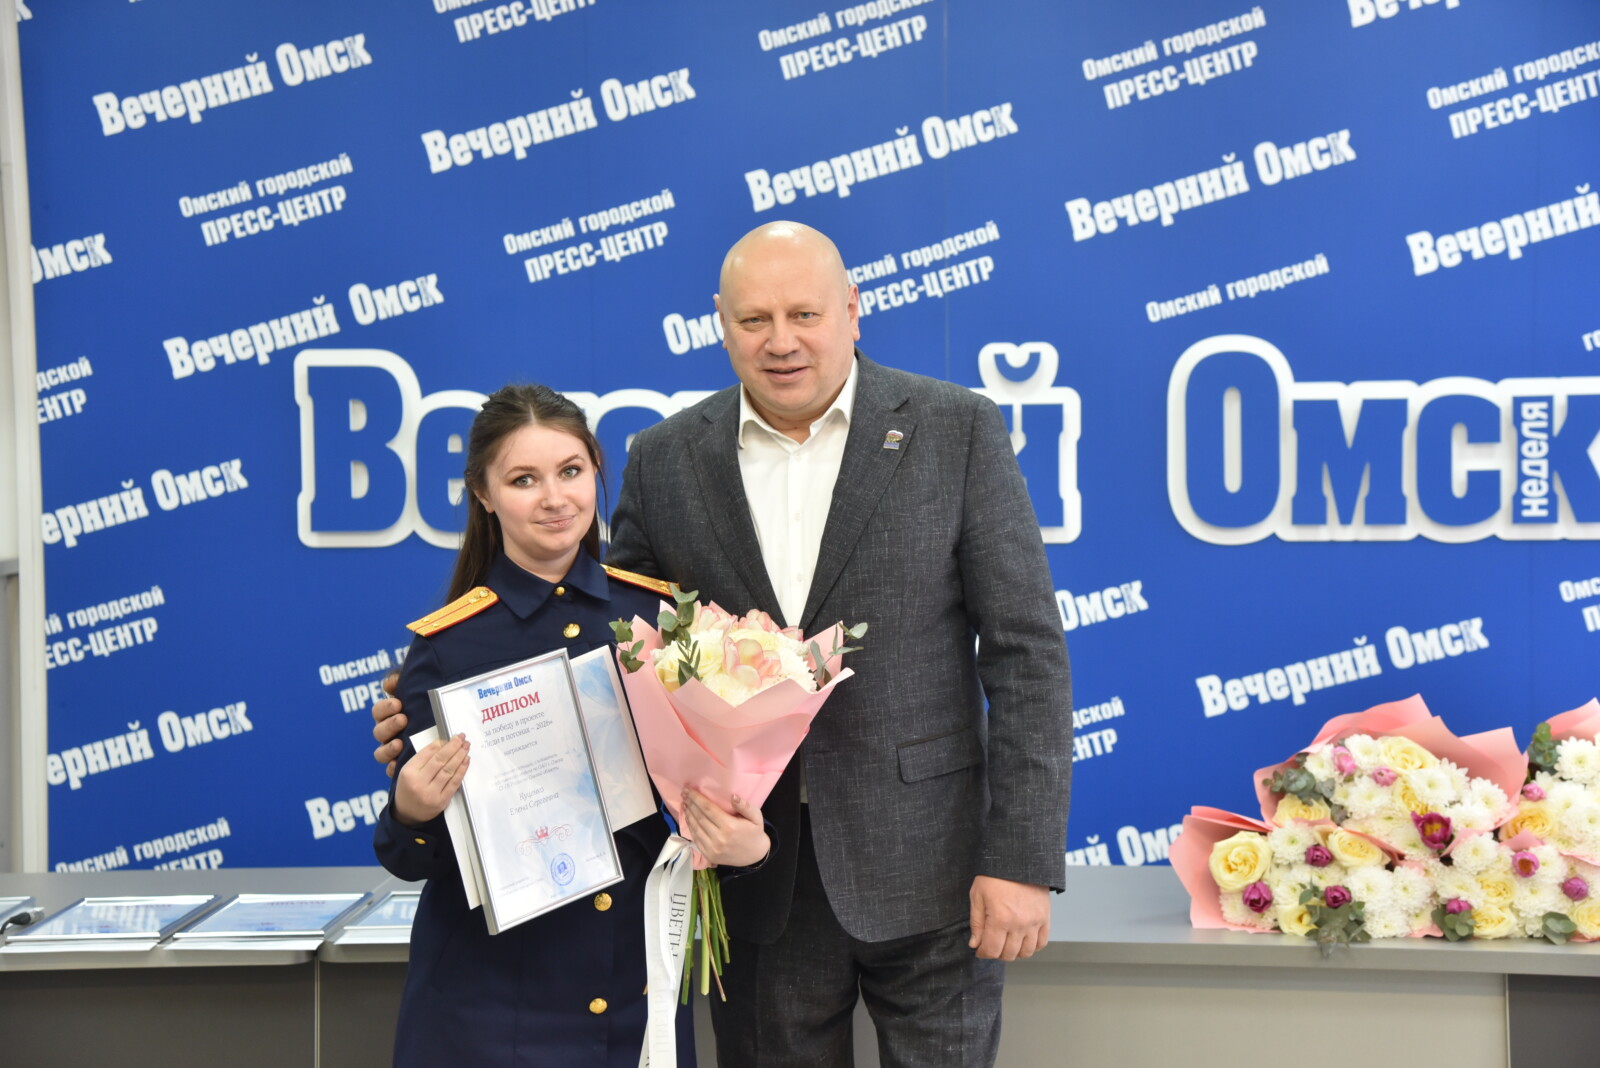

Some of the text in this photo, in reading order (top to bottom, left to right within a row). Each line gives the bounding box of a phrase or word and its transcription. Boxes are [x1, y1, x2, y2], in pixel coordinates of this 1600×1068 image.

[759, 13, 831, 51] Омский
[780, 15, 927, 80] ПРЕСС-ЦЕНТР
[1082, 7, 1266, 80] Омский городской
[93, 34, 372, 136] Вечерний Омск
[1104, 41, 1257, 109] ПРЕСС-ЦЕНТР
[1427, 41, 1600, 109] Омский городск
[1449, 70, 1600, 138] ПРЕСС-ЦЕНТ
[422, 68, 696, 173] Вечерний Омск
[179, 153, 352, 217] Омский городской
[745, 103, 1018, 212] Вечерний Омск
[1065, 129, 1356, 241] Вечерний Омск
[201, 186, 346, 246] ПРЕСС-ЦЕНТР
[503, 189, 675, 254] Омский городской
[1406, 183, 1600, 276] Вечерний
[525, 222, 668, 282] ПРЕСС-ЦЕНТР
[850, 221, 1000, 288] ский городской
[1146, 254, 1329, 322] Омский городской
[163, 274, 444, 379] Вечерний Омск
[38, 357, 92, 392] дской
[1168, 335, 1600, 544] Омск
[1521, 402, 1548, 517] неделя
[42, 459, 248, 548] ерний Омск
[68, 586, 164, 628] городской
[47, 618, 157, 669] ЕСС-ЦЕНТР
[320, 650, 390, 685] Омский
[1196, 618, 1489, 717] Вечерний Омск
[481, 691, 541, 724] ДИПЛОМ
[520, 711, 545, 726] проекте
[48, 702, 252, 790] ерний Омск
[134, 818, 230, 860] городской
